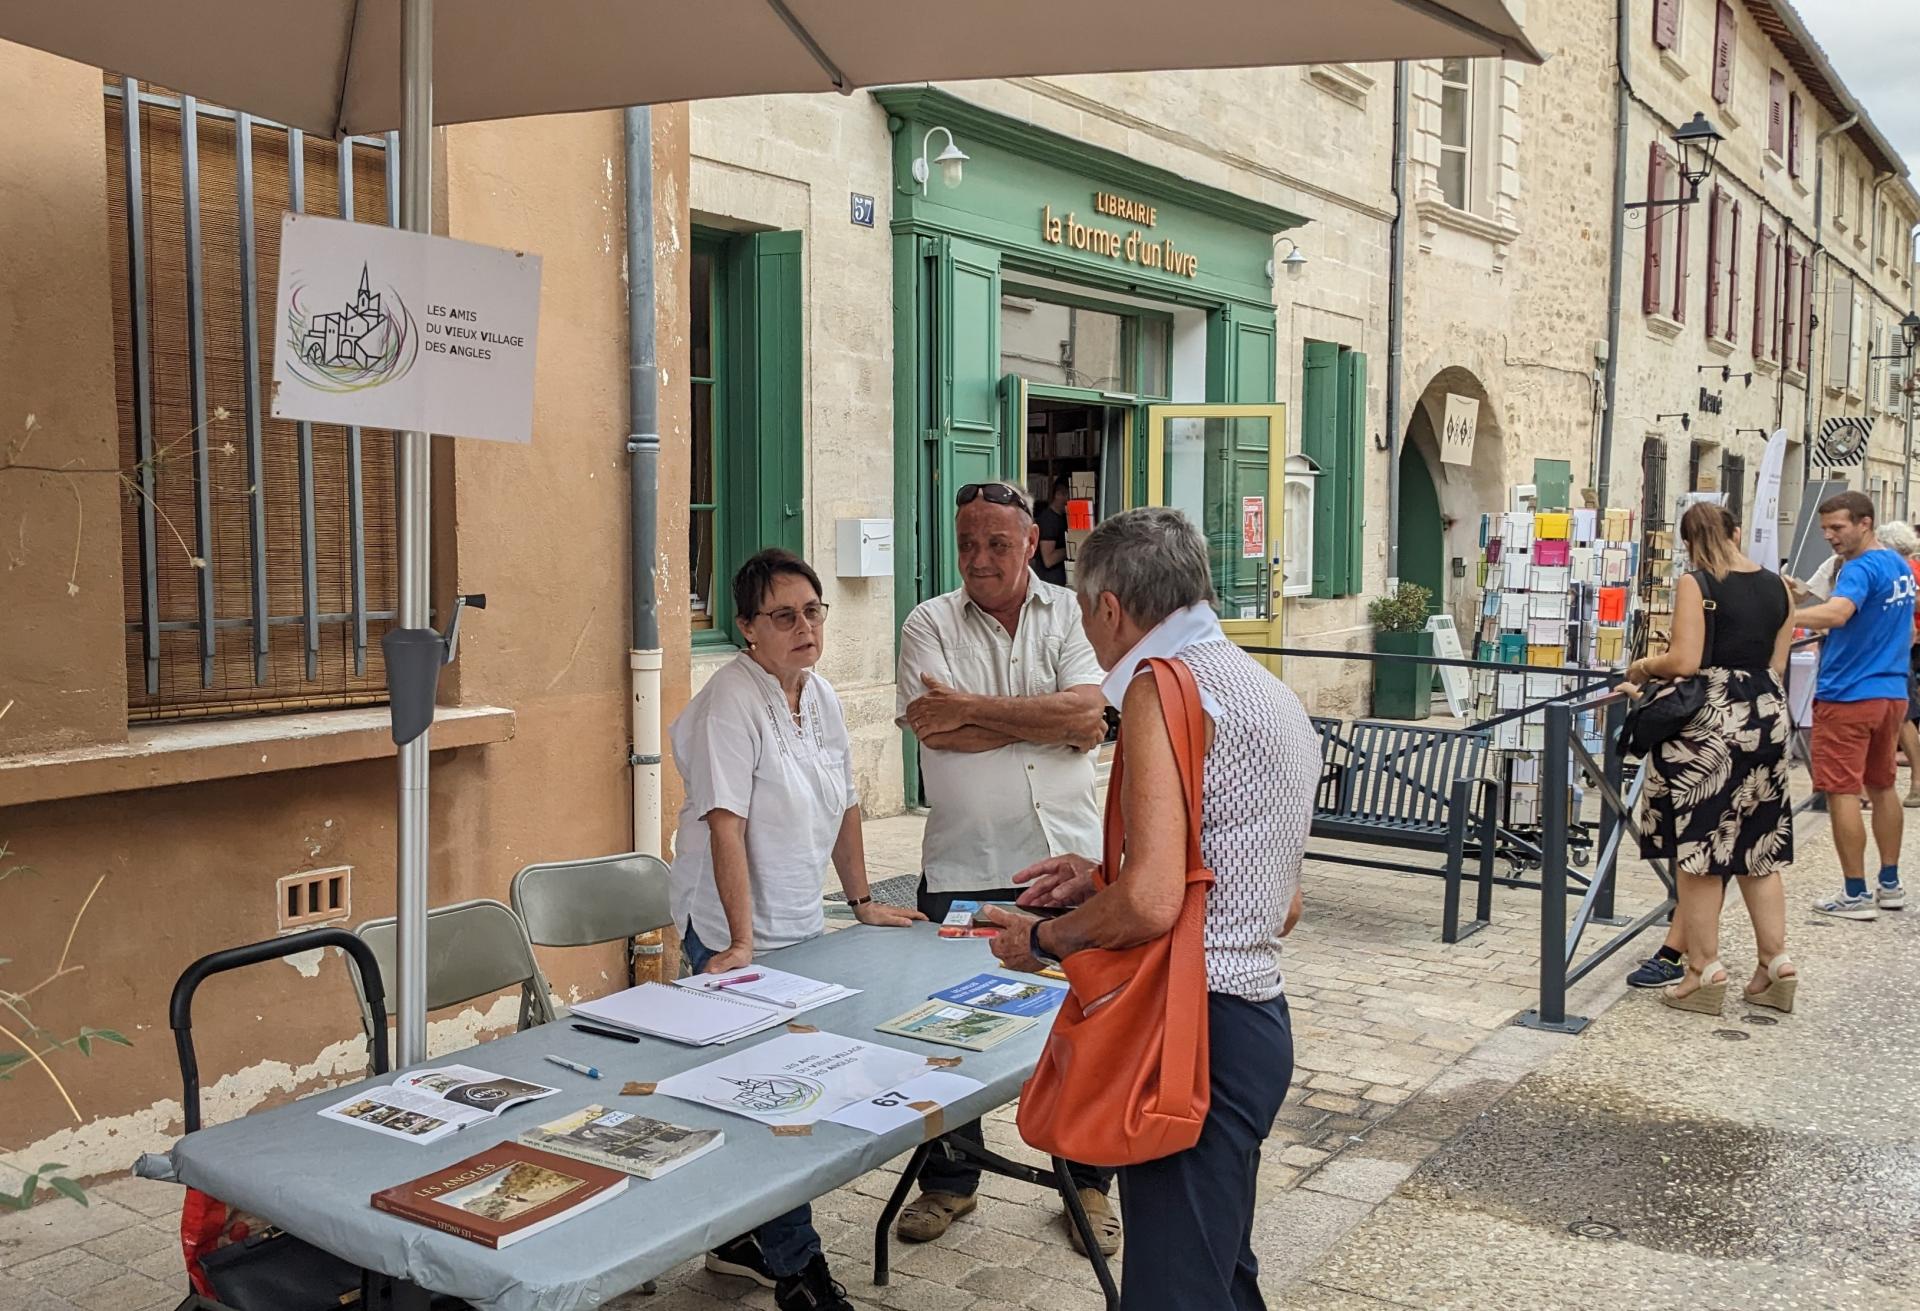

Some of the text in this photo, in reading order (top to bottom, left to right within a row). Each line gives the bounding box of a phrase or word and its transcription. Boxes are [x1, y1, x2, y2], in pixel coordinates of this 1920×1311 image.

[854, 196, 872, 222] 57
[1096, 191, 1157, 227] LIBRAIRIE
[1044, 205, 1199, 278] la forme d'un livre
[426, 304, 478, 322] LES AMIS
[426, 322, 525, 347] DU VIEUX VILLAGE
[425, 340, 492, 360] DES ANGLES
[799, 1053, 822, 1065] AMIS
[808, 1057, 833, 1070] VIEUX
[831, 1044, 866, 1060] VILLAGE
[827, 1056, 859, 1071] ANGLES
[871, 1091, 910, 1107] 67
[414, 1162, 497, 1197] LES ANGLES
[437, 1220, 461, 1234] ANGLES
[460, 1228, 472, 1239] LES
